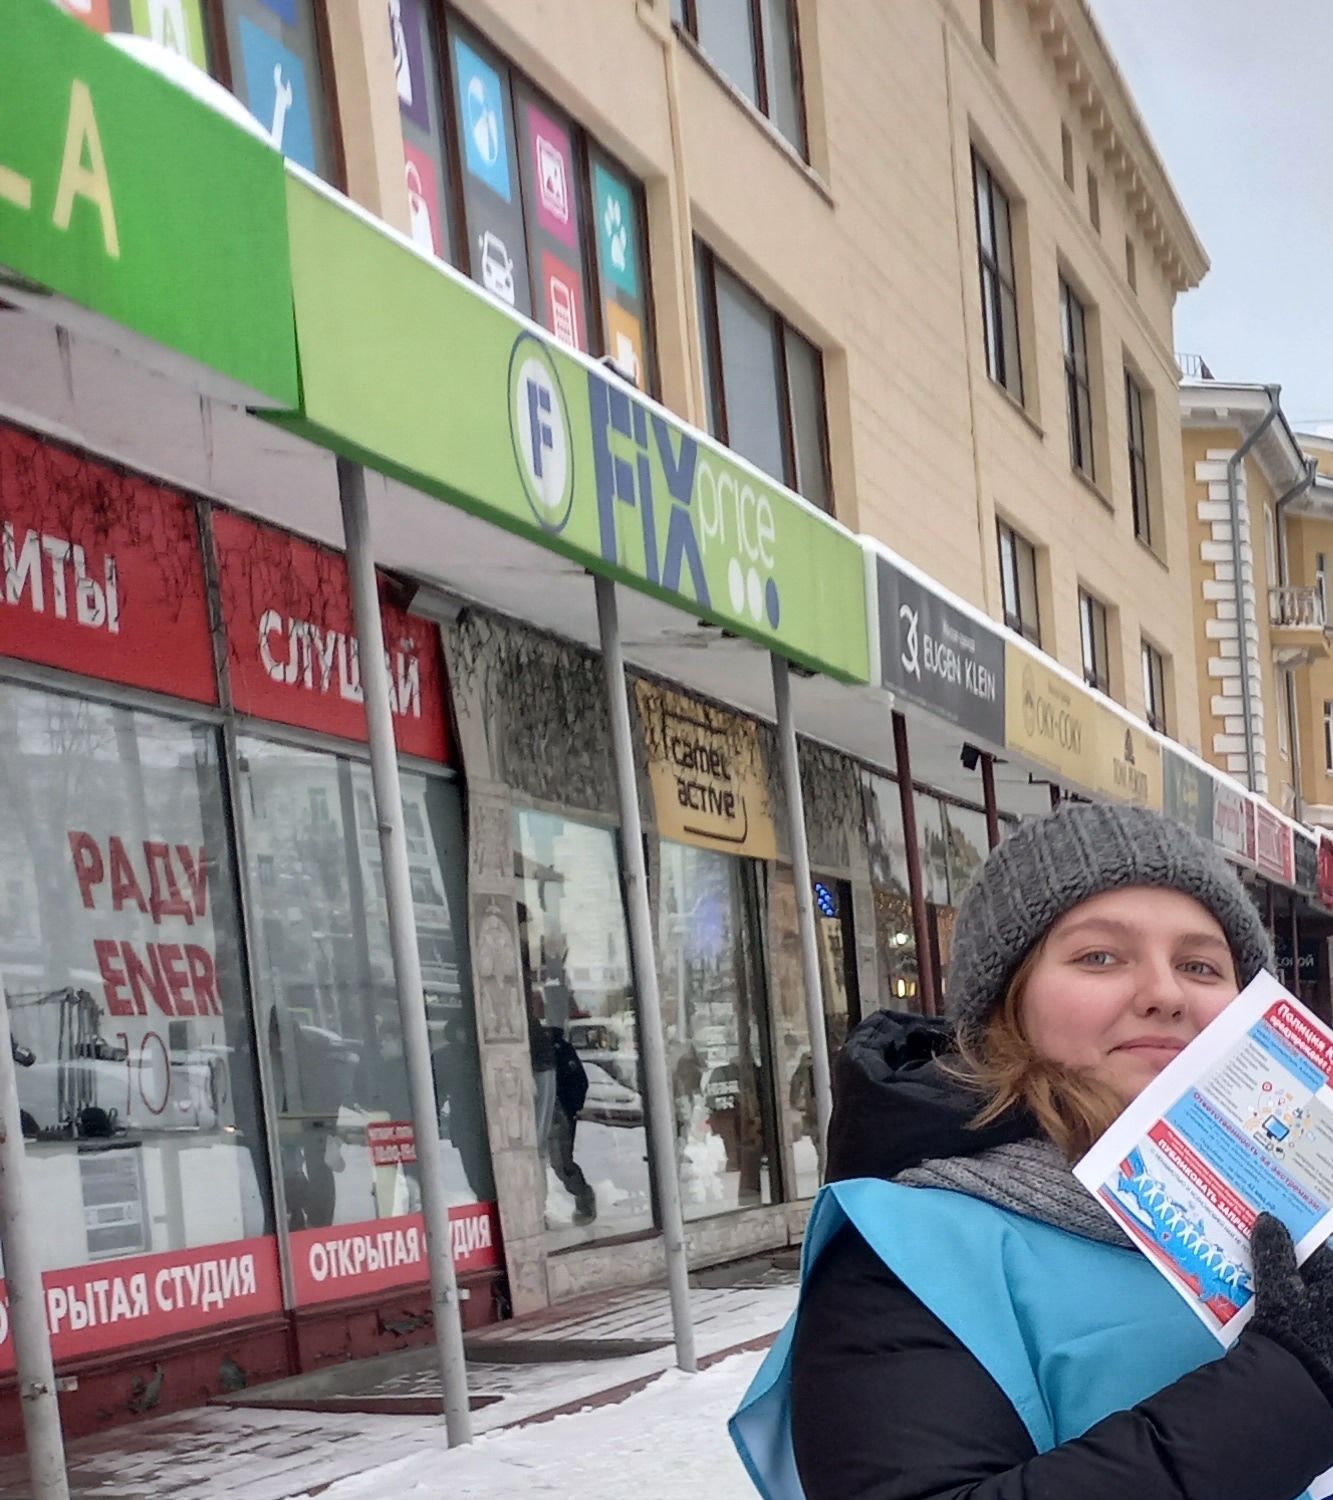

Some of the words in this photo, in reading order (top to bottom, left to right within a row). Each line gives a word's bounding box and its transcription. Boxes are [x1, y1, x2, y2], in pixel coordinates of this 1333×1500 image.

[587, 370, 712, 612] FIX
[697, 459, 776, 570] price
[258, 608, 421, 718] СЛУШЙ
[923, 633, 962, 686] EUGEN
[964, 656, 996, 702] KLEIN
[671, 735, 731, 781] camel
[676, 776, 735, 819] active
[93, 938, 224, 1017] ENER
[1275, 1002, 1327, 1052] Полиция
[1156, 1138, 1219, 1203] ПУБЛИКОВАТЬ
[1215, 1200, 1255, 1240] ЗАПРЕЩ
[155, 1254, 256, 1312] СТУДИЯ
[309, 1227, 421, 1283] ОТКРЫТАЯ
